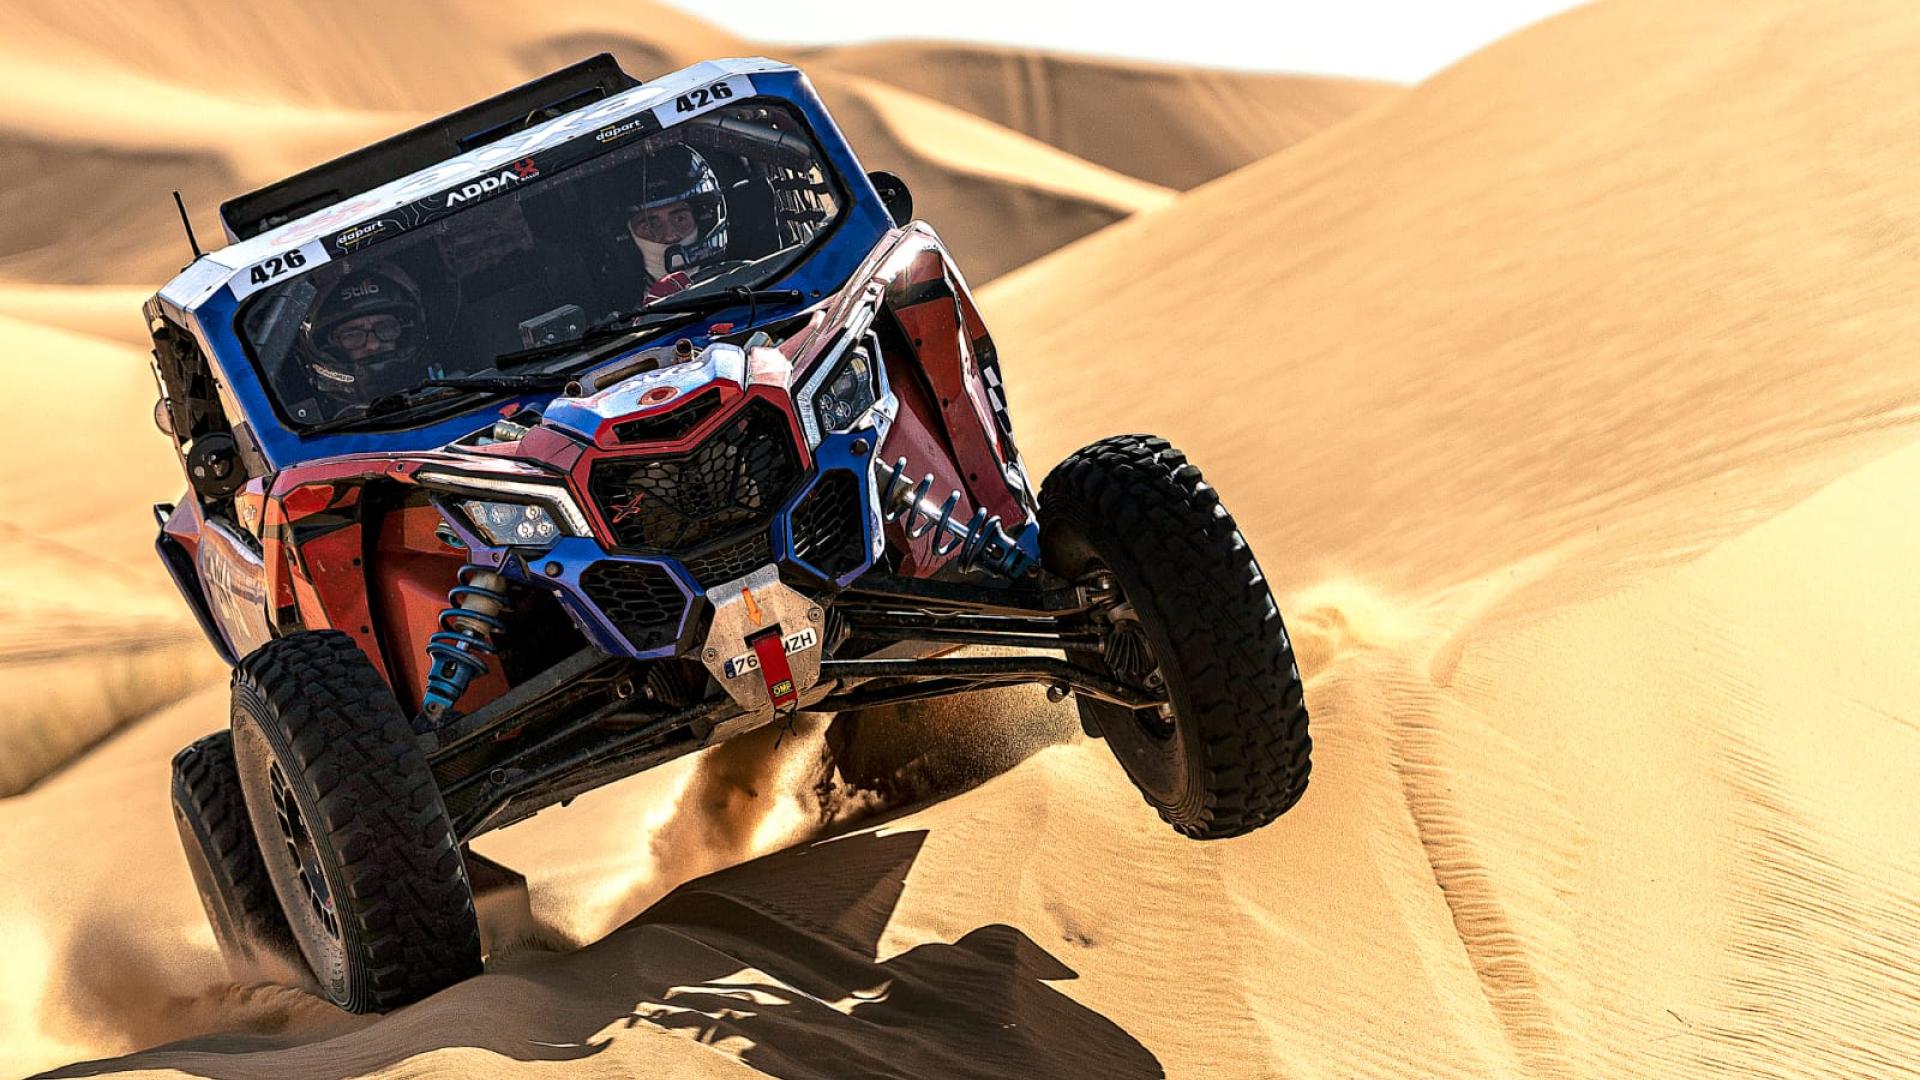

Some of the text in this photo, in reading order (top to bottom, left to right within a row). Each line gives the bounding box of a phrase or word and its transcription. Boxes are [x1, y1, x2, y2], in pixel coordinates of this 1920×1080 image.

[675, 82, 733, 113] 426
[596, 119, 642, 141] dapart
[338, 220, 384, 244] dapart
[250, 249, 307, 285] 426
[735, 654, 758, 673] 76
